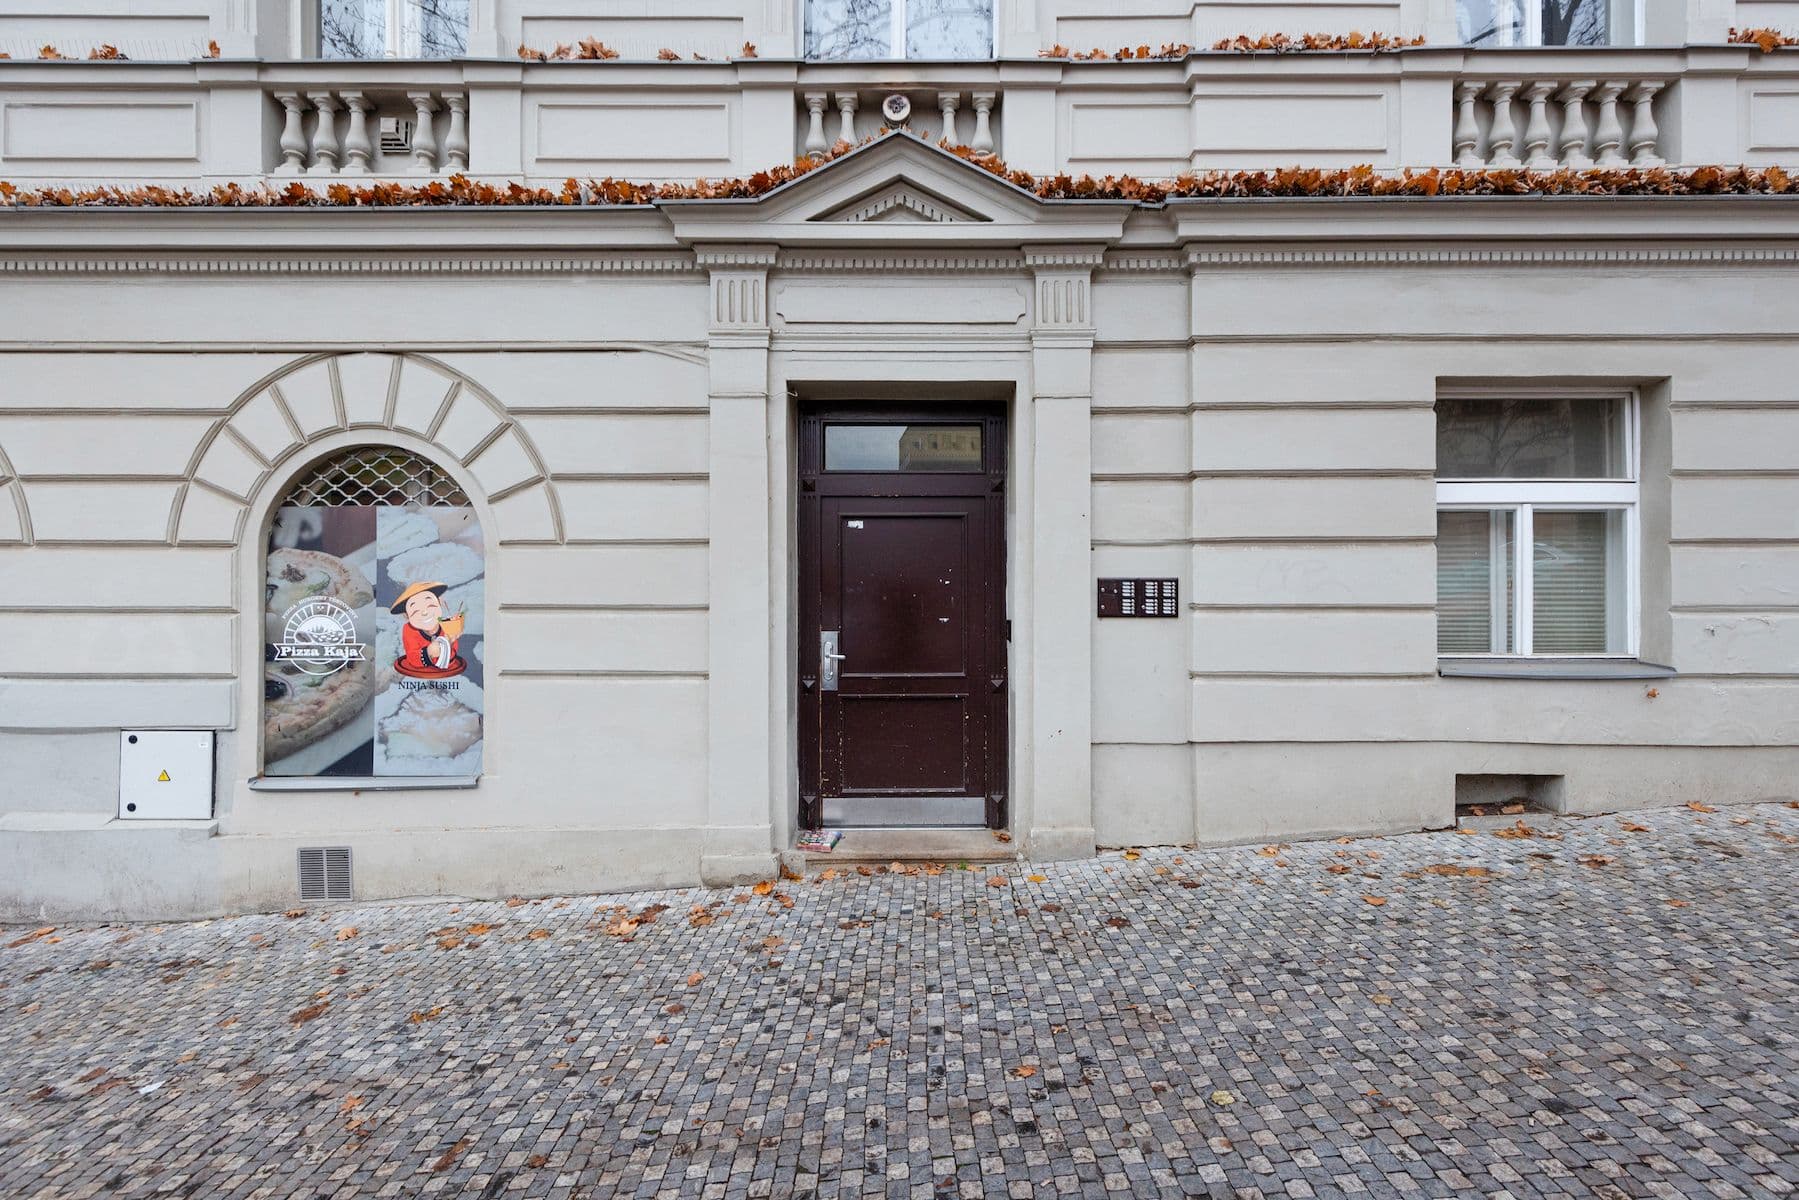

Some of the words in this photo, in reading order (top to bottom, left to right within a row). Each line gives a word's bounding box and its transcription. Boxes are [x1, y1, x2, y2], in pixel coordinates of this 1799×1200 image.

[280, 646, 319, 656] Pizza
[324, 646, 358, 658] Kaja
[398, 681, 427, 691] NINJA
[428, 681, 459, 690] SUSHI
